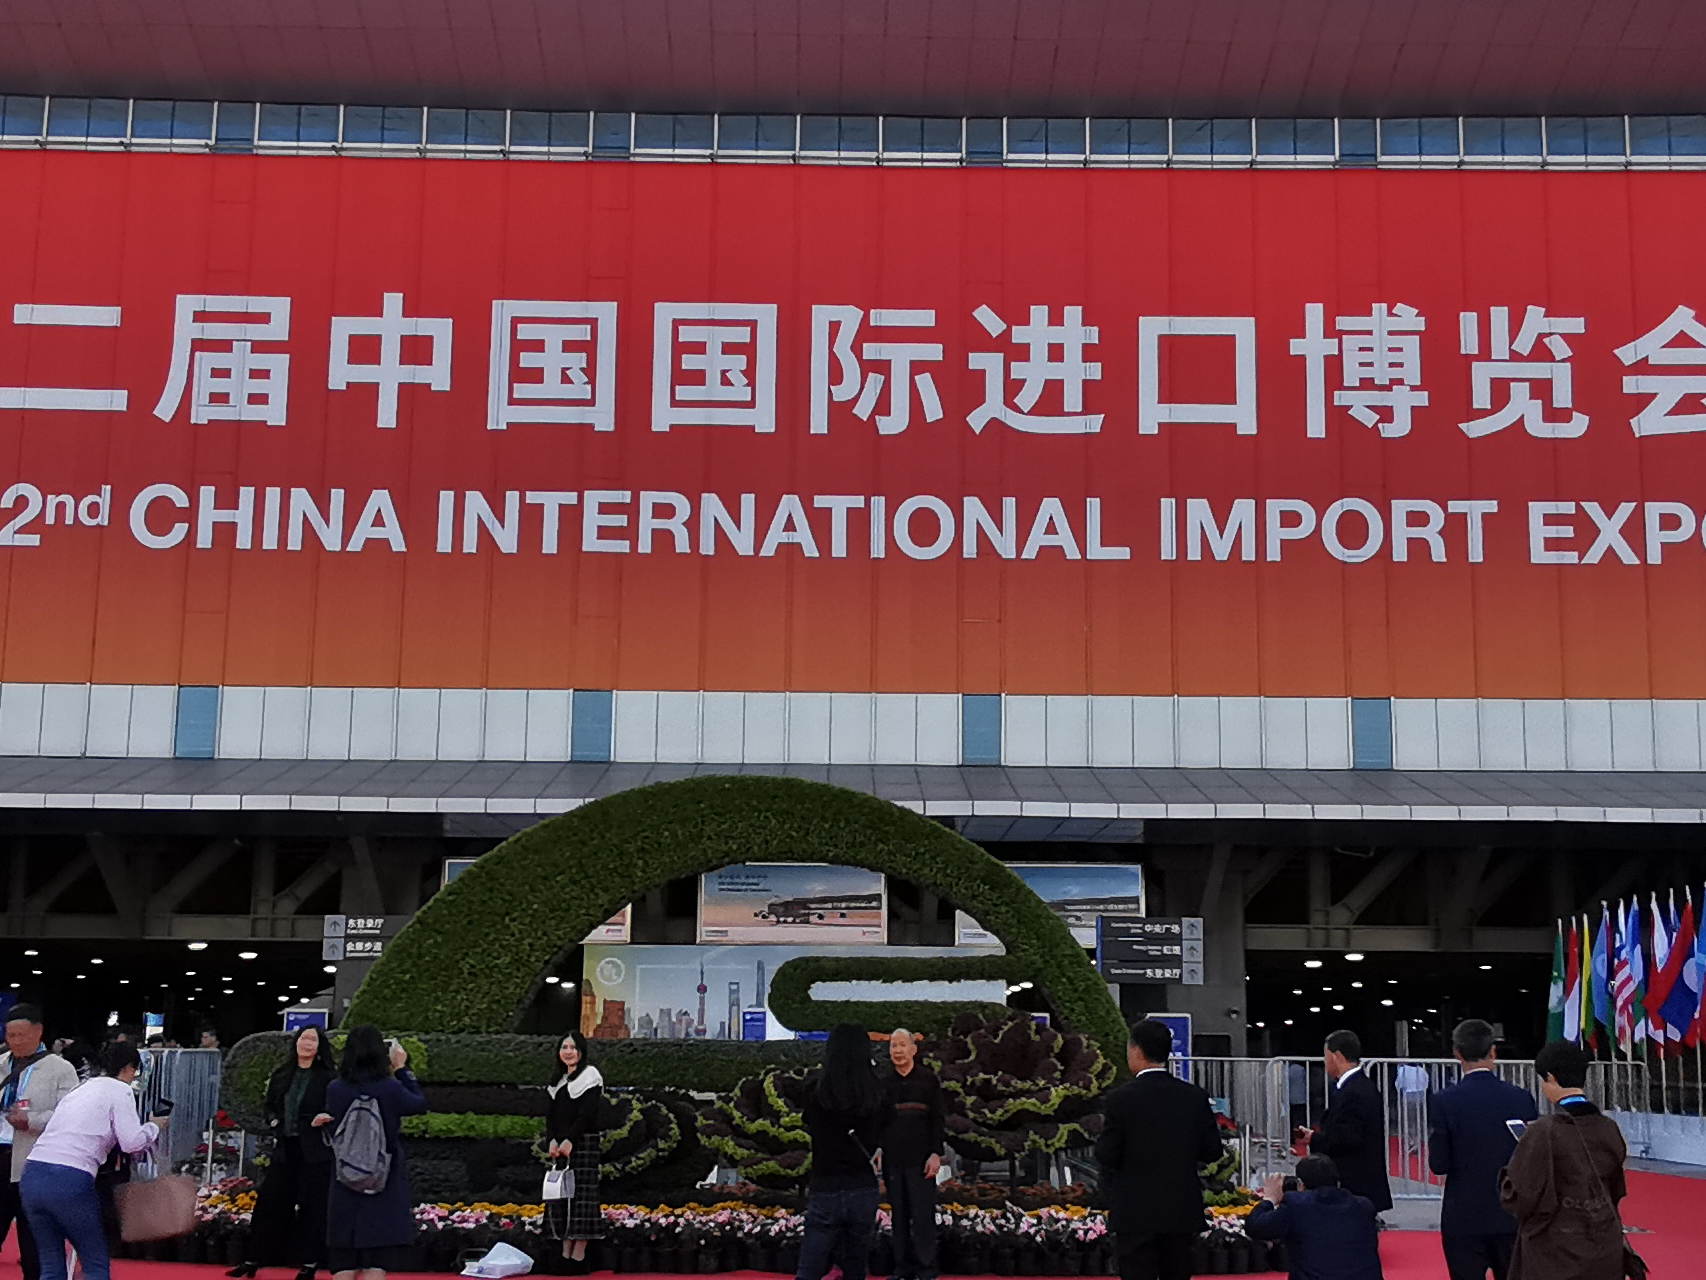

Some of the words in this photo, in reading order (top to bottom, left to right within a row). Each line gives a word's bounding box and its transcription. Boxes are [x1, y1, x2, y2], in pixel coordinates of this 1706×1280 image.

[129, 483, 408, 552] CHINA
[436, 489, 1131, 560] INTERNATIONAL
[1160, 497, 1499, 563] IMPORT
